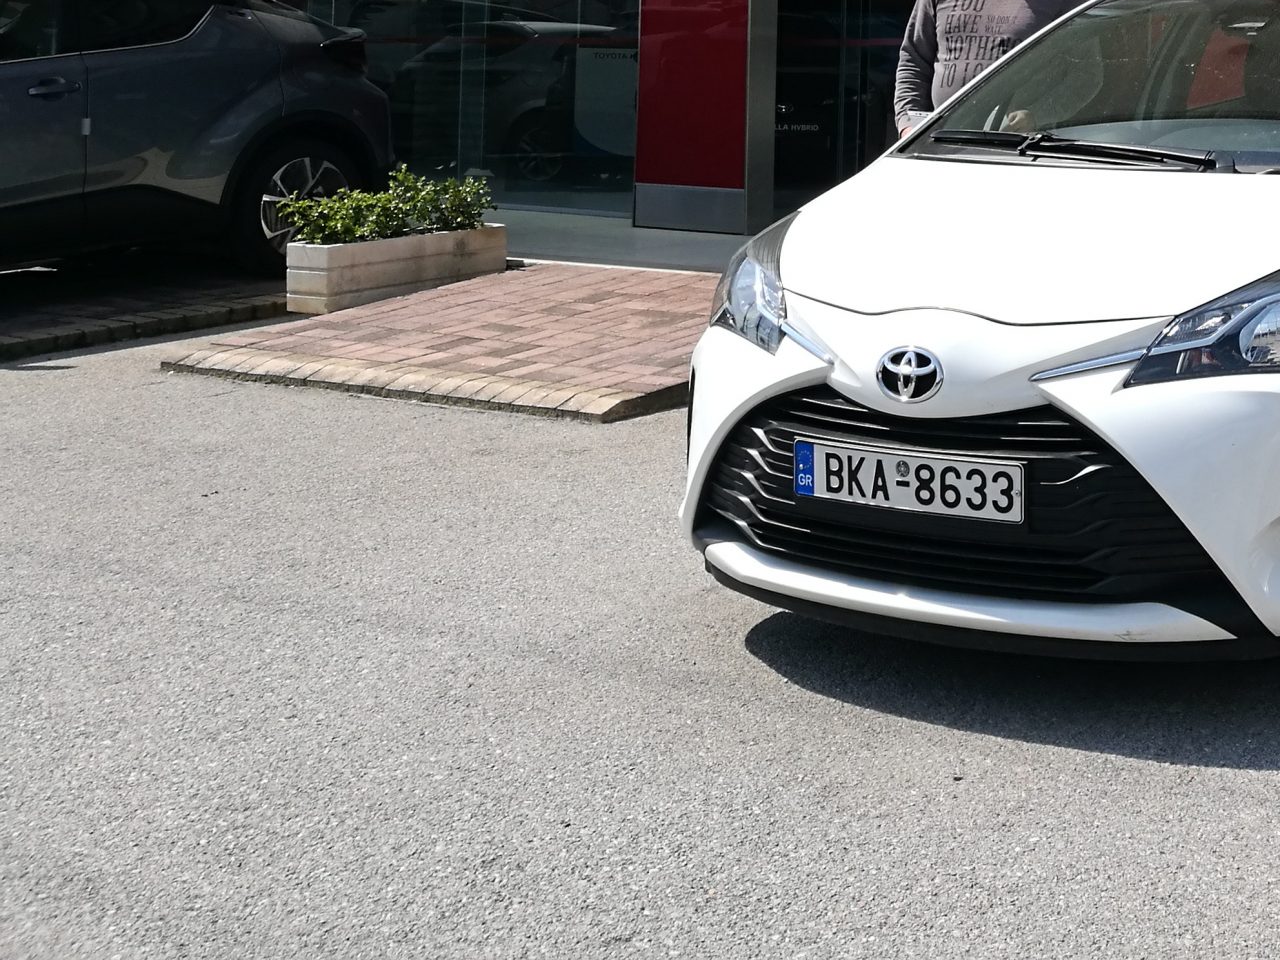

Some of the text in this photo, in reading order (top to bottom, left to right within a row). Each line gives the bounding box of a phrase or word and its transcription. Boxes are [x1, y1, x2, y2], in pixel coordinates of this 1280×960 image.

[945, 13, 982, 35] HAVE
[944, 35, 1022, 63] NOTHIN
[940, 63, 957, 89] TO
[798, 451, 1014, 514] GR BKA-8633
